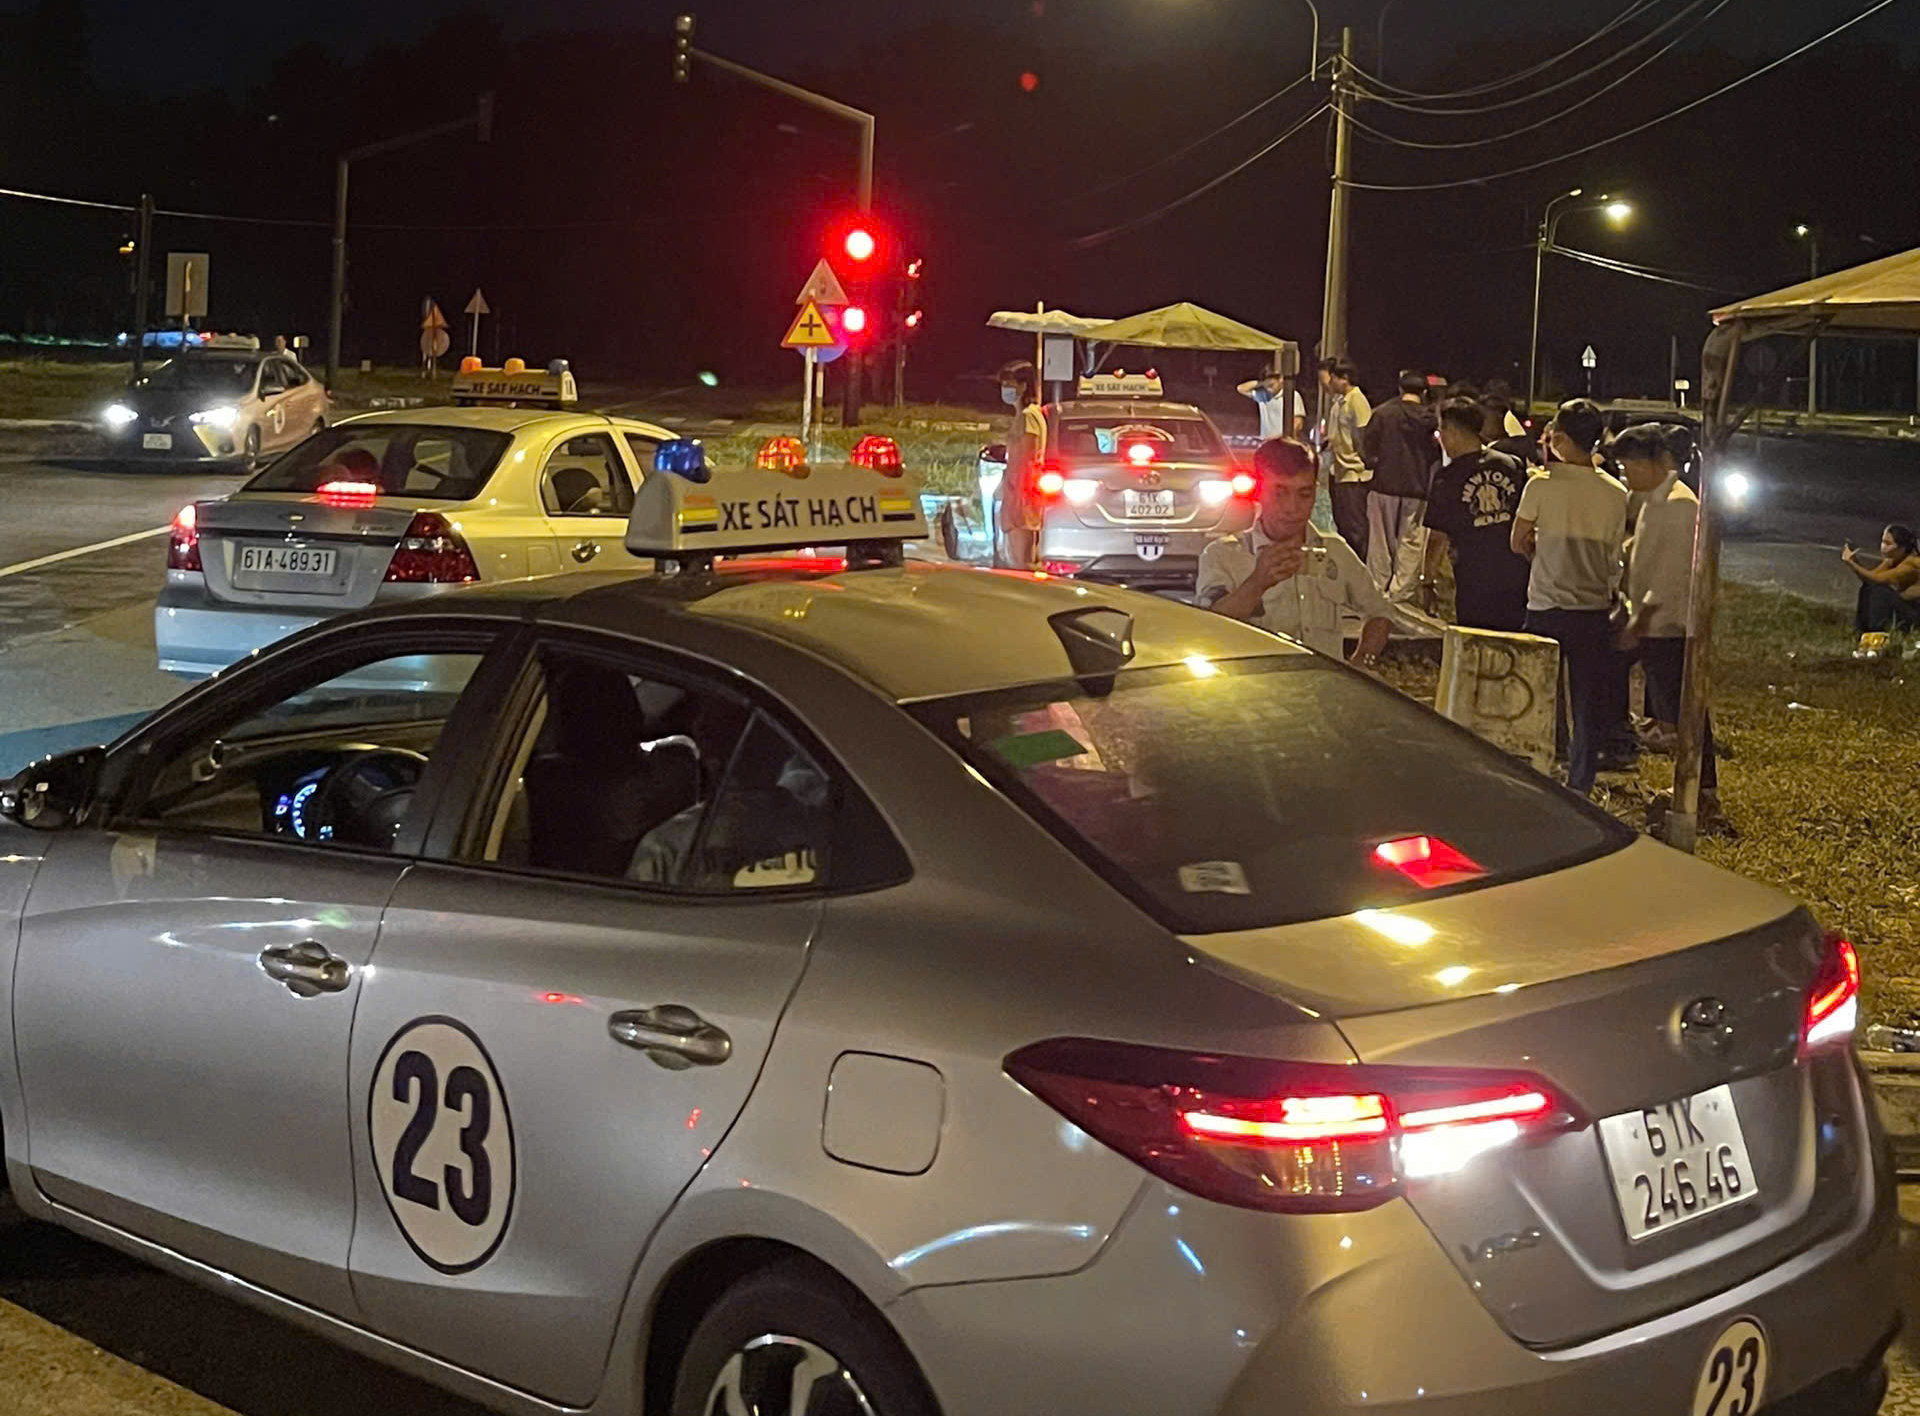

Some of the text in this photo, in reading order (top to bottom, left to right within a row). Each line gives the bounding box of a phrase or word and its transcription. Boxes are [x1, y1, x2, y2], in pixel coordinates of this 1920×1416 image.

[471, 381, 485, 394] XE
[721, 493, 878, 532] XE SÁT HẠCH
[1462, 469, 1515, 502] NEW YORK
[1473, 644, 1534, 721] B
[392, 1050, 491, 1226] 23
[1644, 1098, 1704, 1157] 61K
[1634, 1145, 1742, 1228] 246.46
[1705, 1336, 1759, 1416] 23
